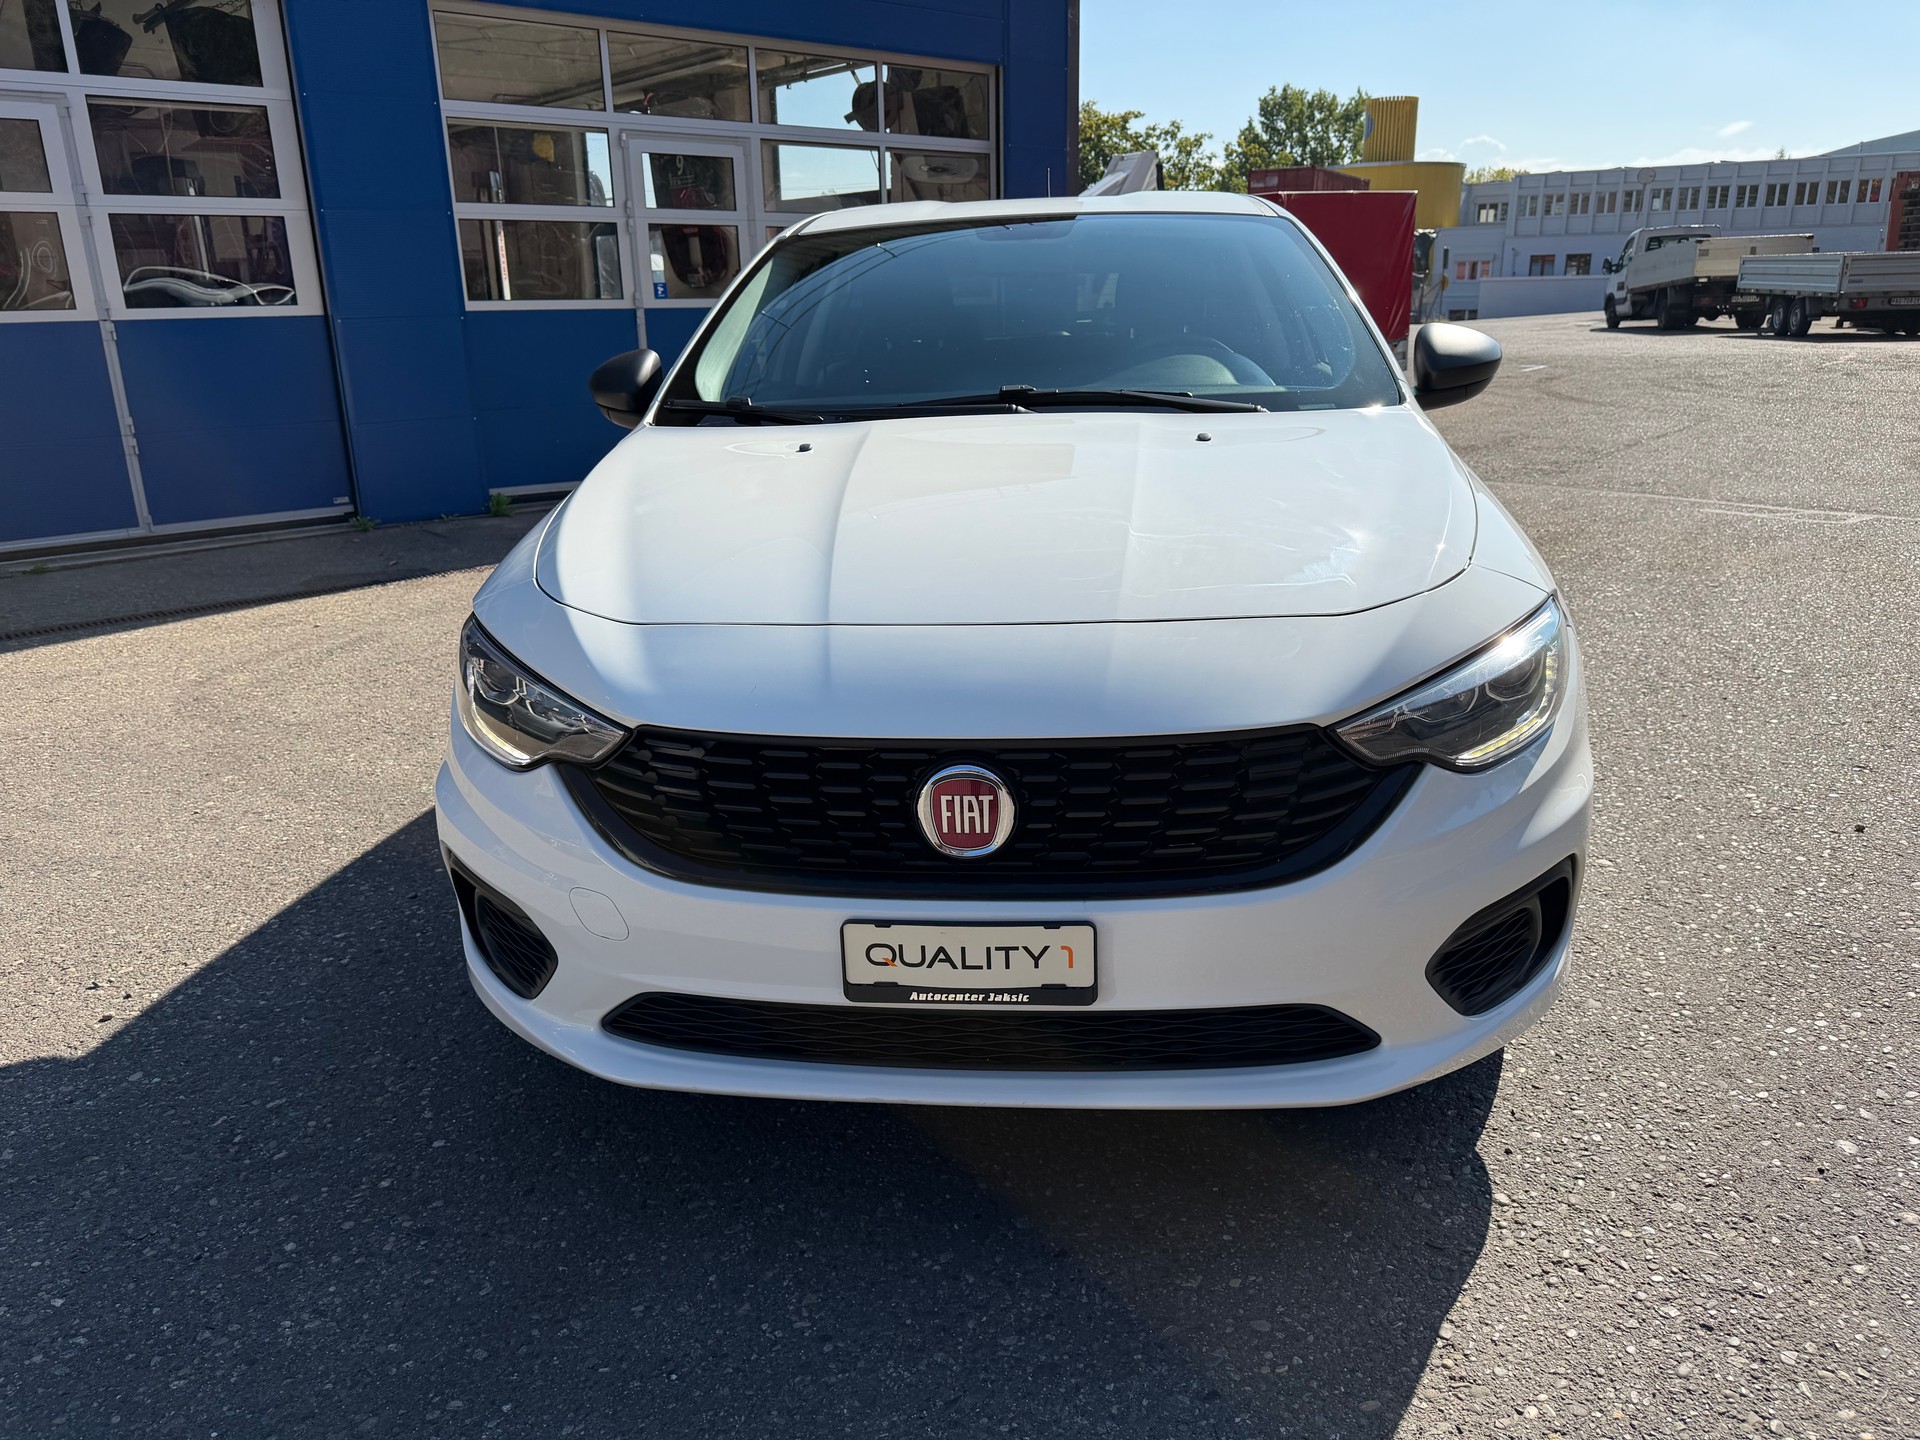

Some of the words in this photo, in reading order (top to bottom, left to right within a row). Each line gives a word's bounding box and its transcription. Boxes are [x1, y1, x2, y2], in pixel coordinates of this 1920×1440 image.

[940, 795, 994, 834] FIAT
[909, 991, 985, 1001] Autocenter
[987, 992, 1030, 1002] Jaksic
